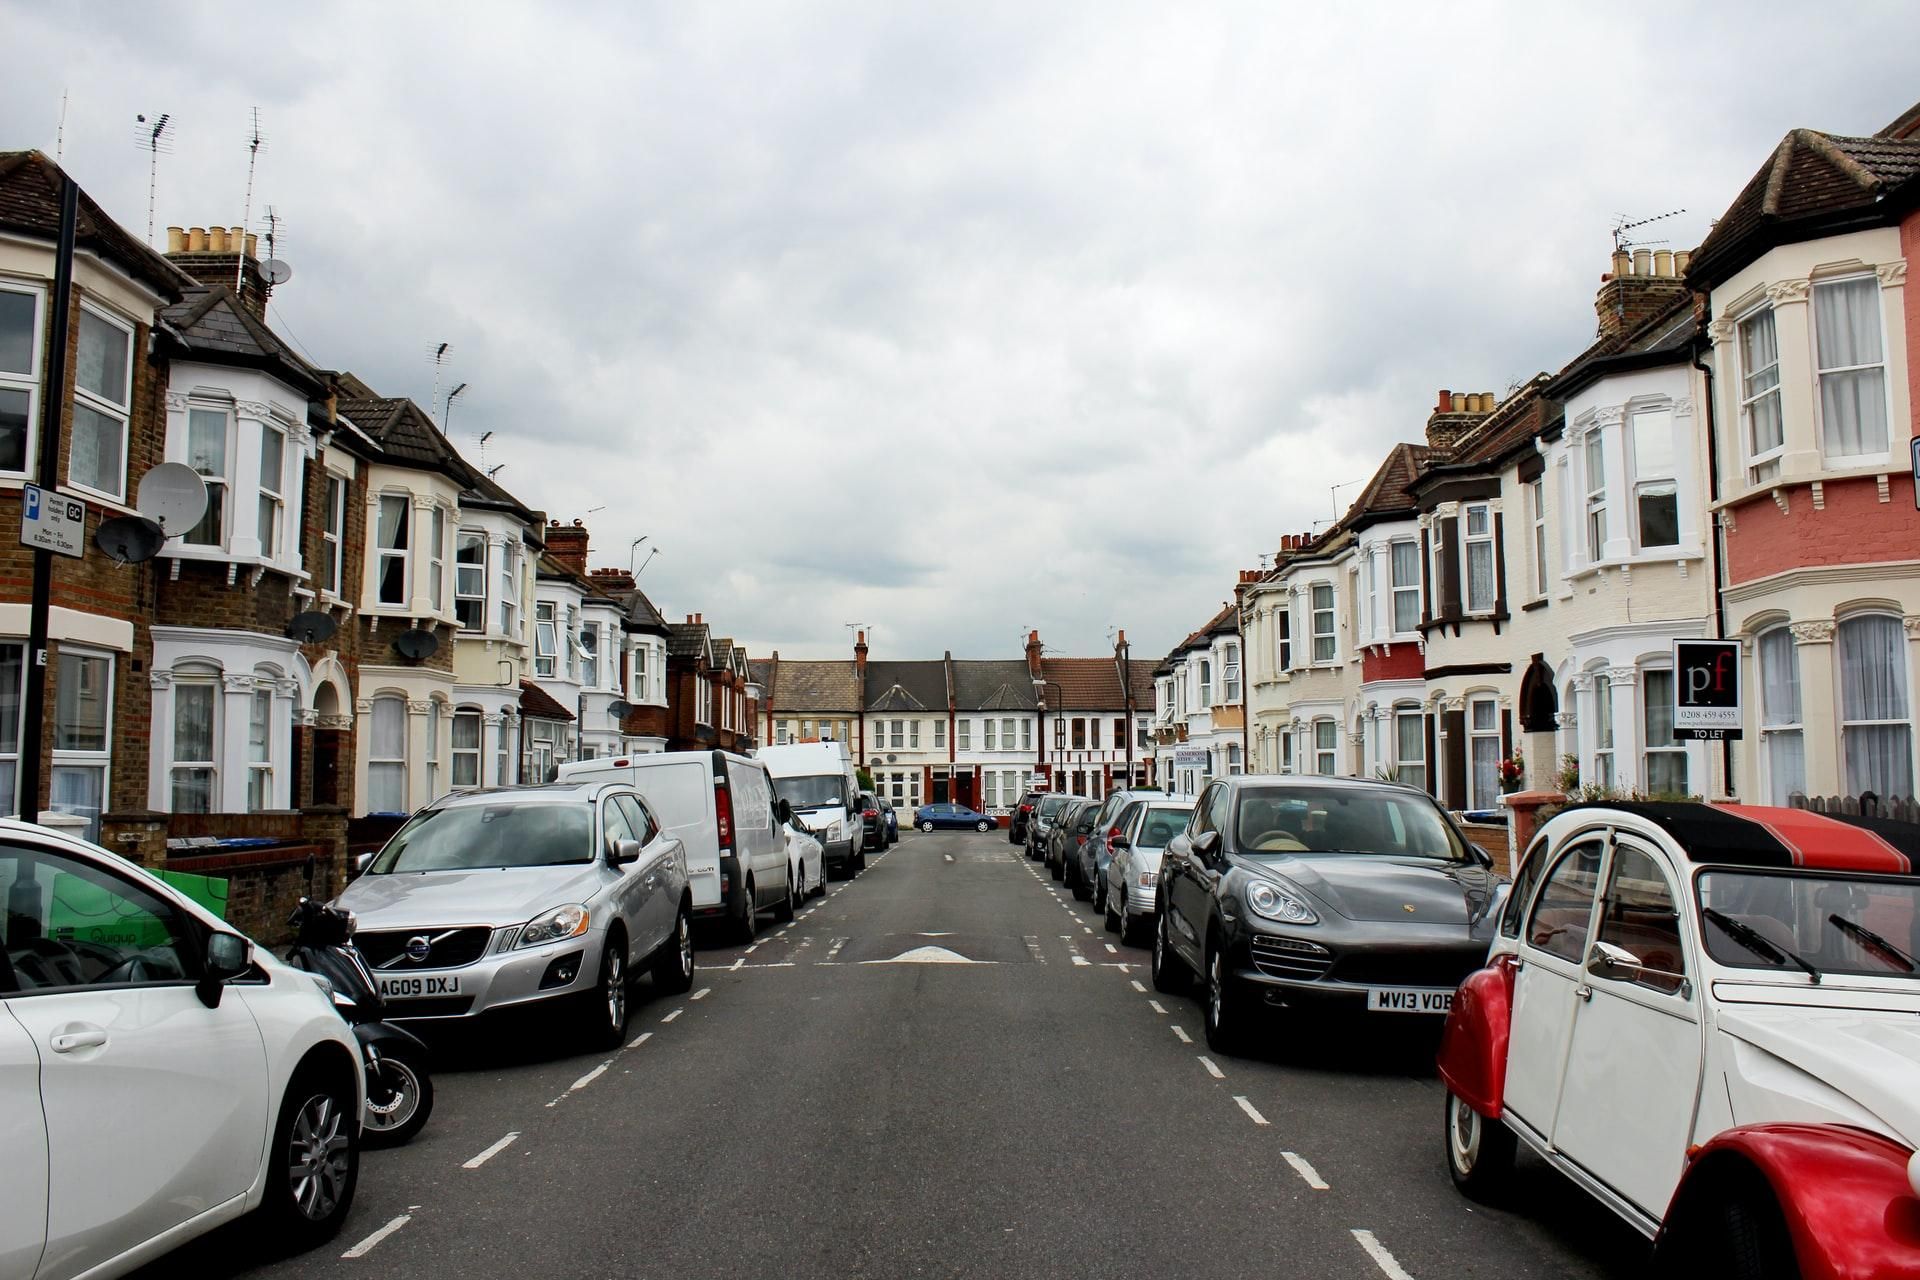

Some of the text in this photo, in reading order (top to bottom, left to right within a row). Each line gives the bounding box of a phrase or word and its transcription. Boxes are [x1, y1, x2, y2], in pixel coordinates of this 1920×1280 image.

[26, 488, 39, 516] P
[49, 497, 64, 506] Permit
[48, 505, 64, 515] holders
[68, 506, 80, 519] GC
[42, 528, 52, 536] Mon
[1693, 730, 1725, 738] TO LET
[381, 977, 458, 995] AG09 DXJ
[1380, 992, 1416, 1008] MV13
